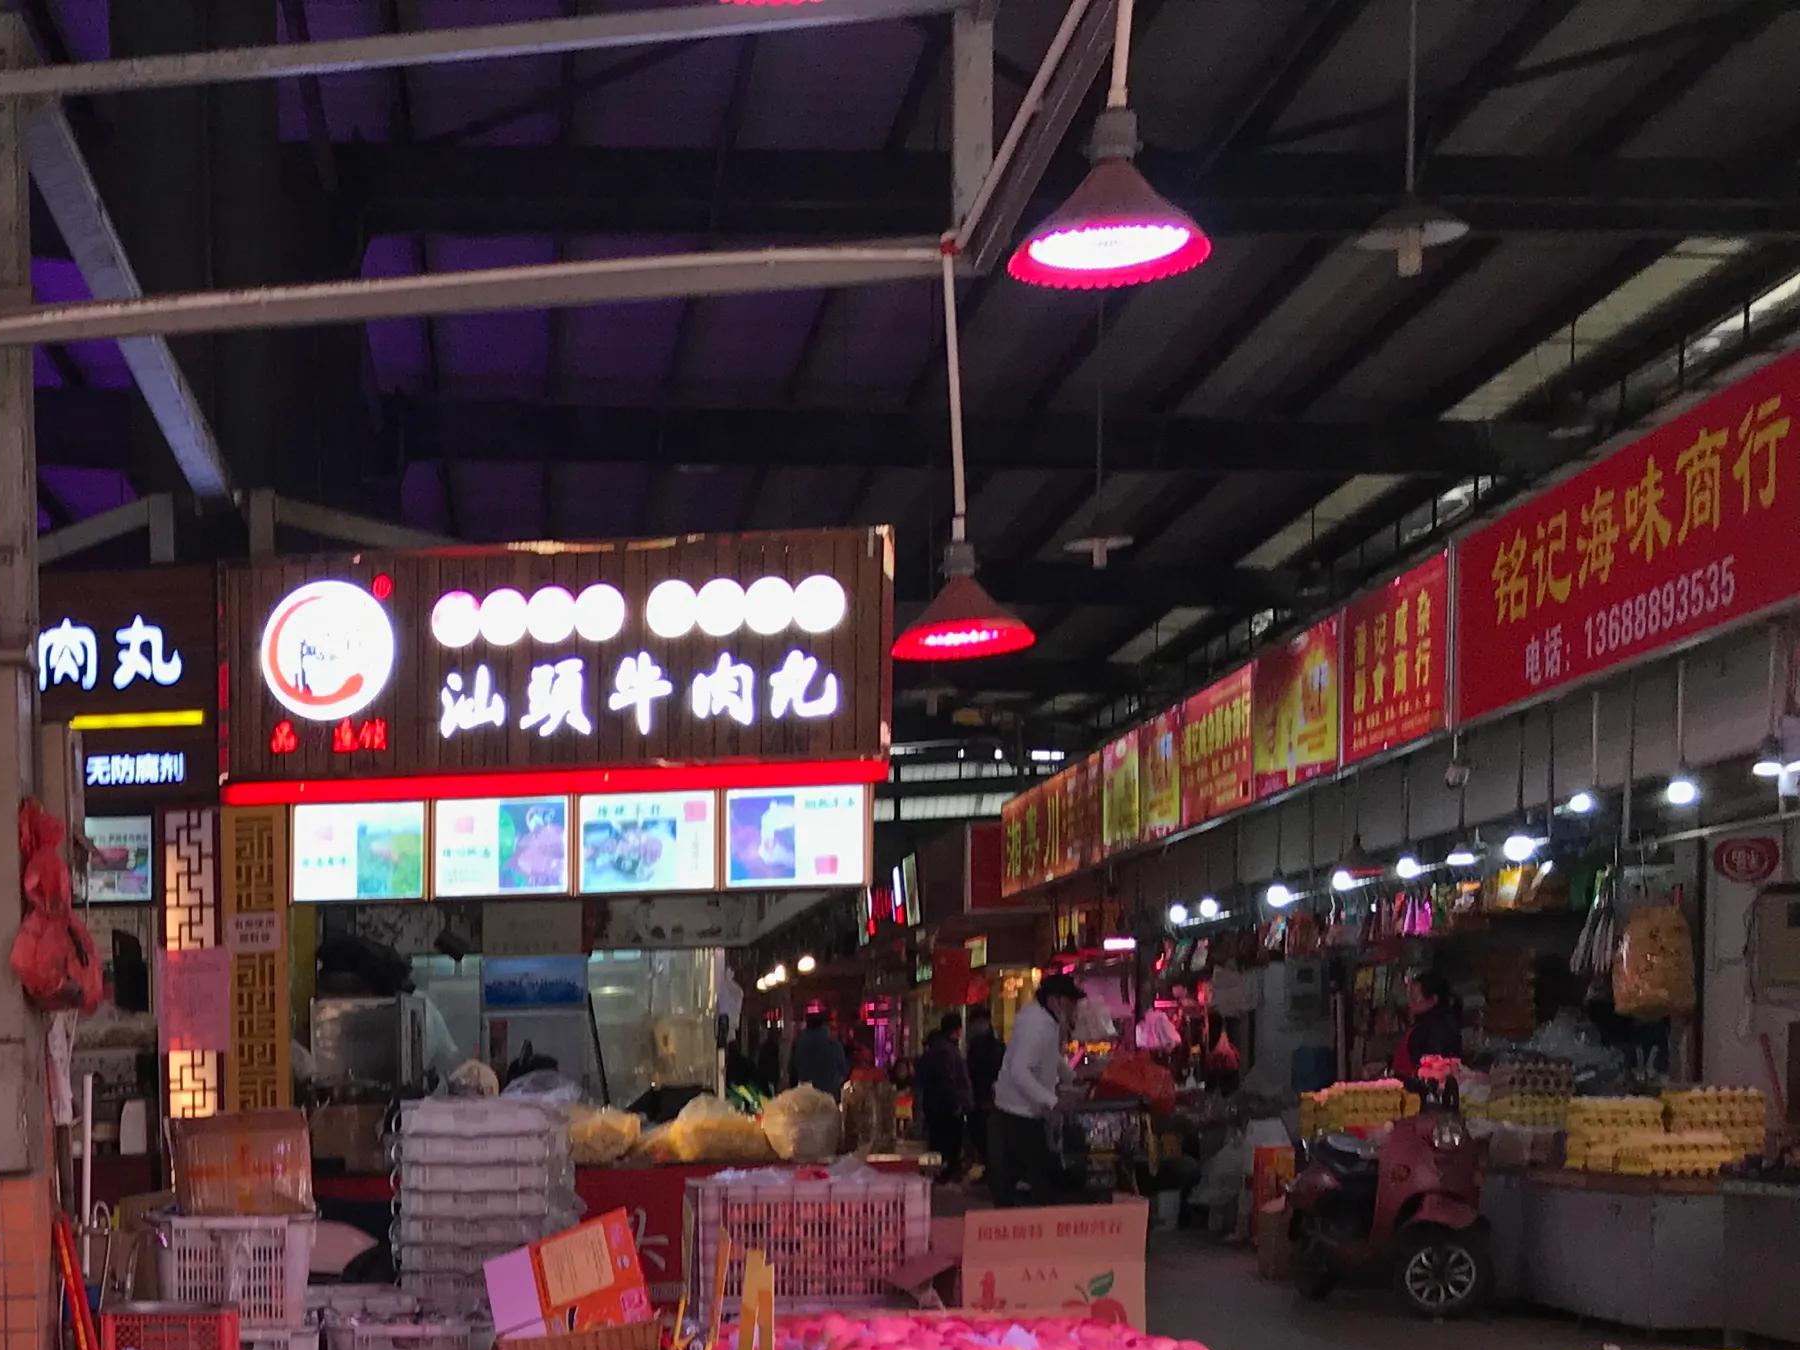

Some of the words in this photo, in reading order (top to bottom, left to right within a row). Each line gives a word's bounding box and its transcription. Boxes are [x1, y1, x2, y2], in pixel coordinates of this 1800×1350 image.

[1491, 395, 1790, 625] 铭记海味商行
[1584, 553, 1736, 659] 13688893535
[85, 751, 185, 786] 无防腐剂
